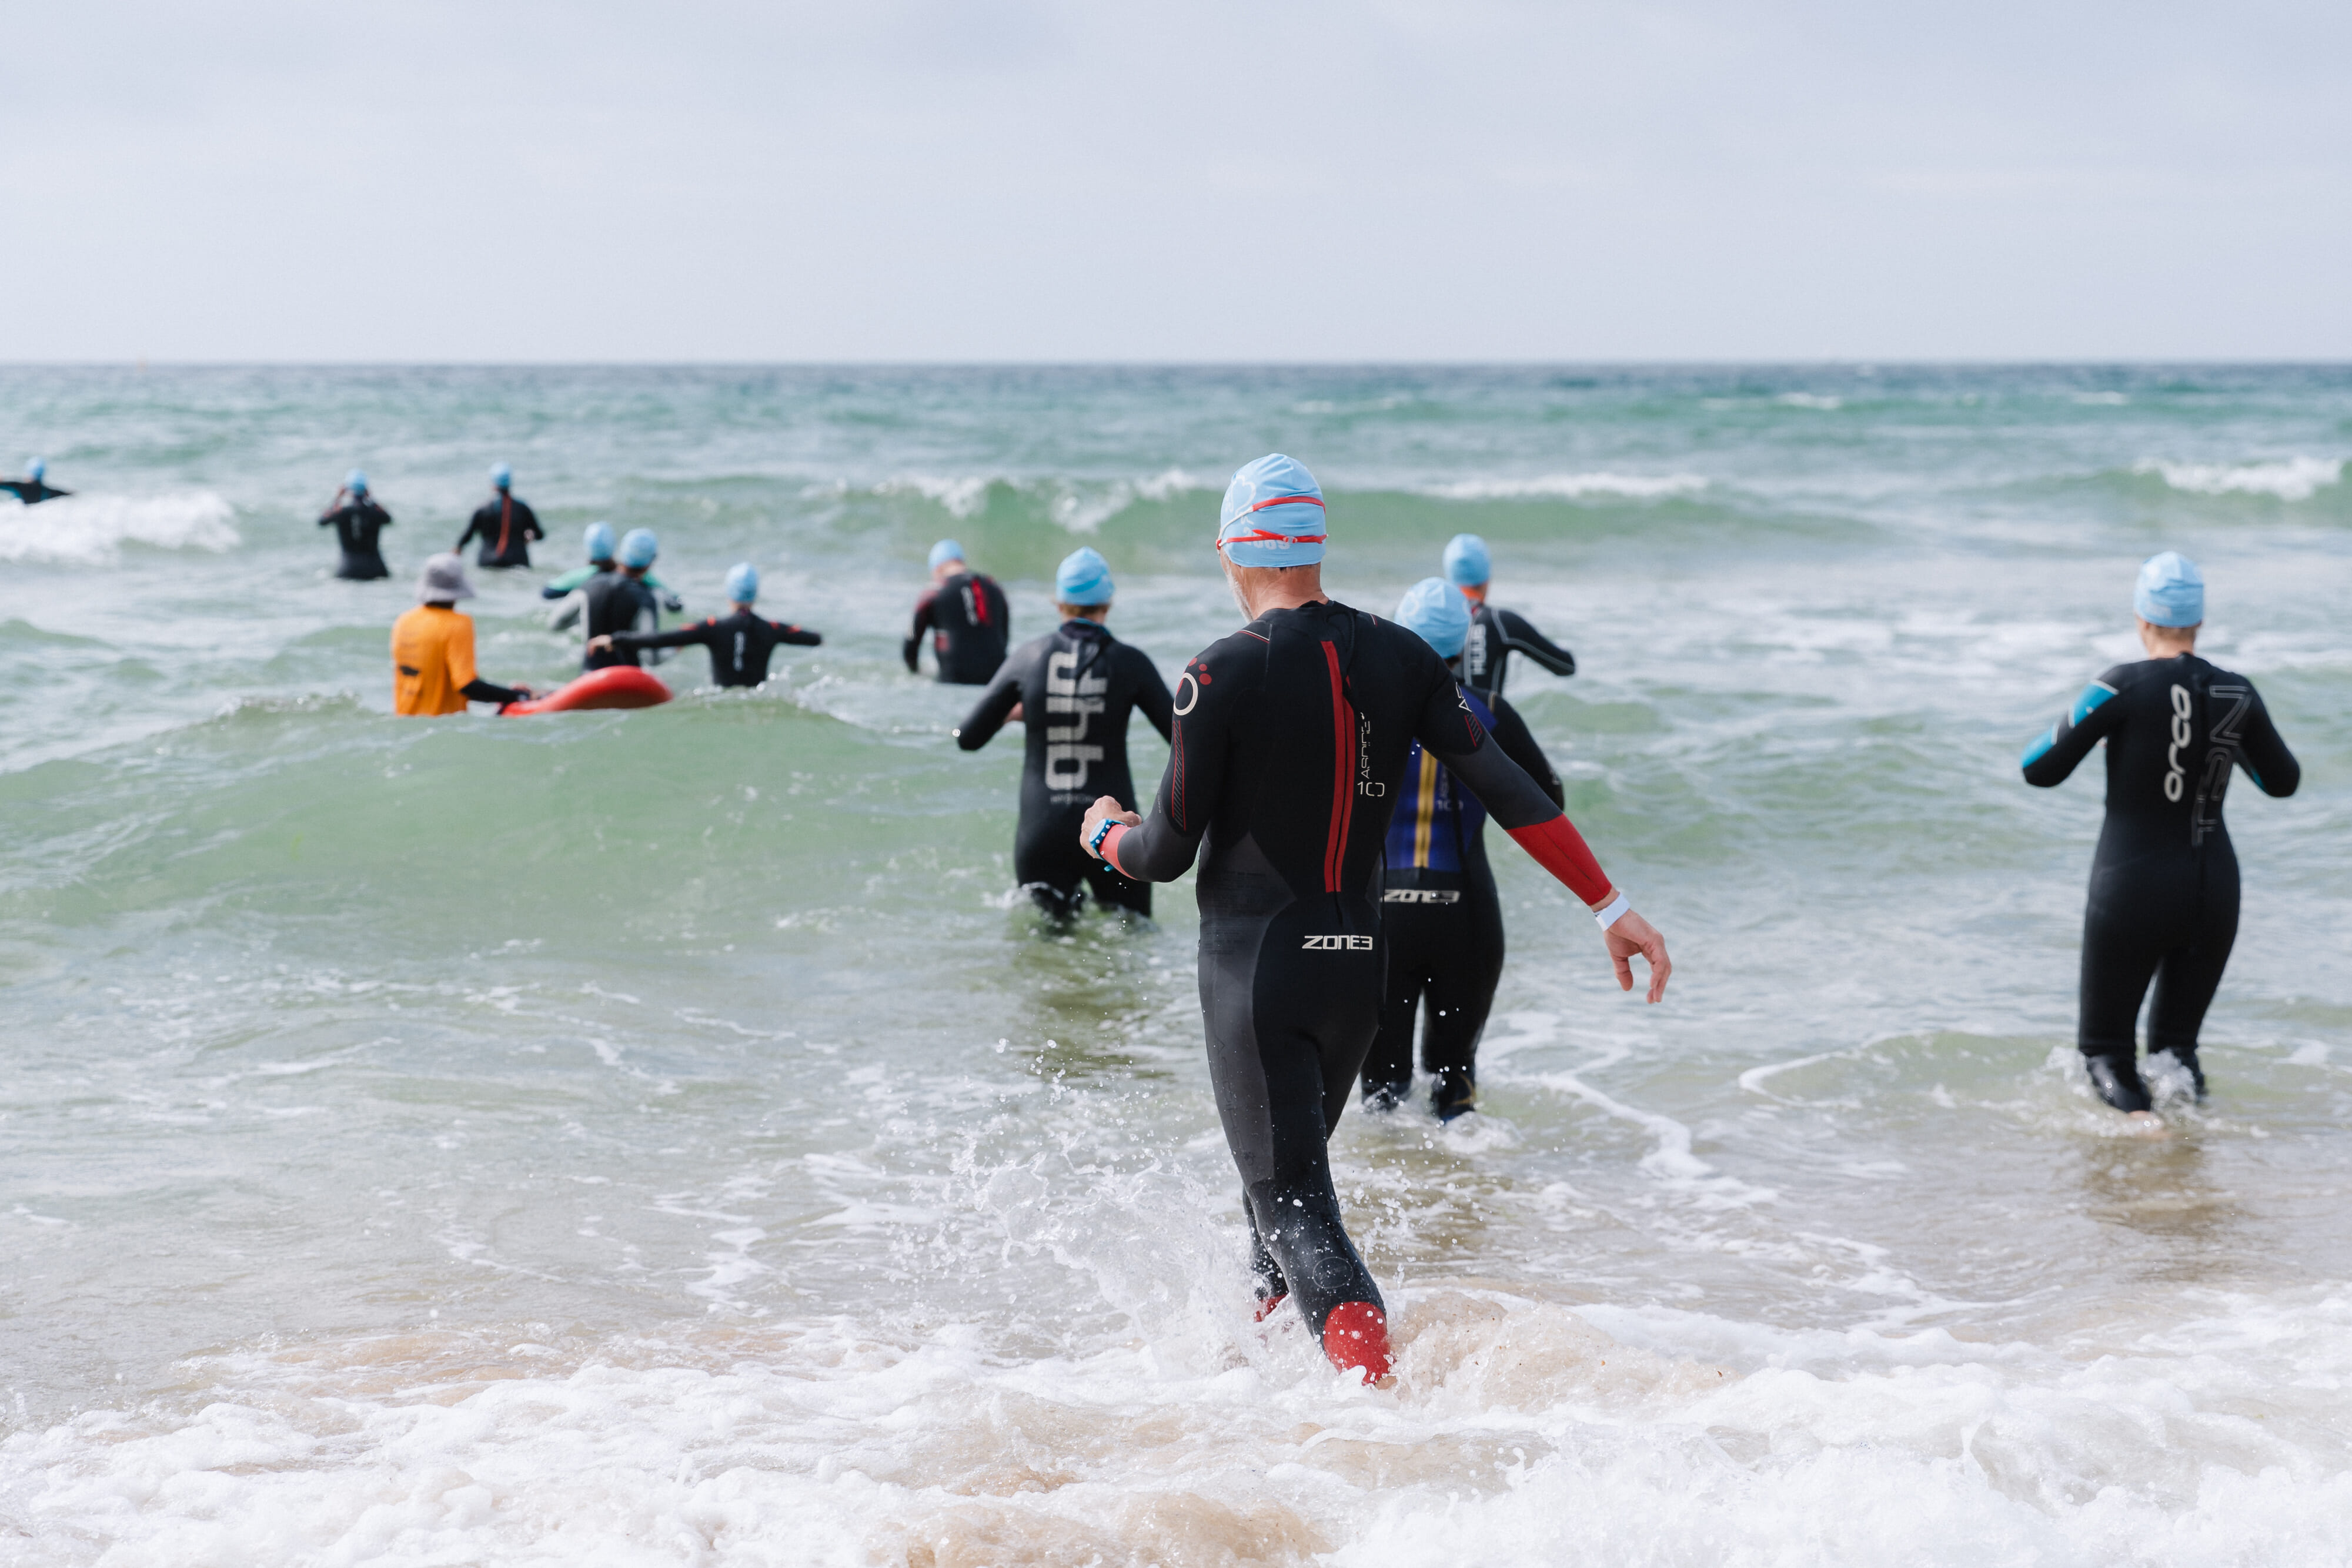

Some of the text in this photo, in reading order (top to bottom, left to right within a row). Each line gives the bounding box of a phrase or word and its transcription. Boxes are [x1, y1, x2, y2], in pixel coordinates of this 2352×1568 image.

[2164, 684, 2192, 803] orca
[1357, 781, 1385, 797] 10
[1379, 889, 1461, 903] ZONE3
[1302, 935, 1373, 951] ZONE3
